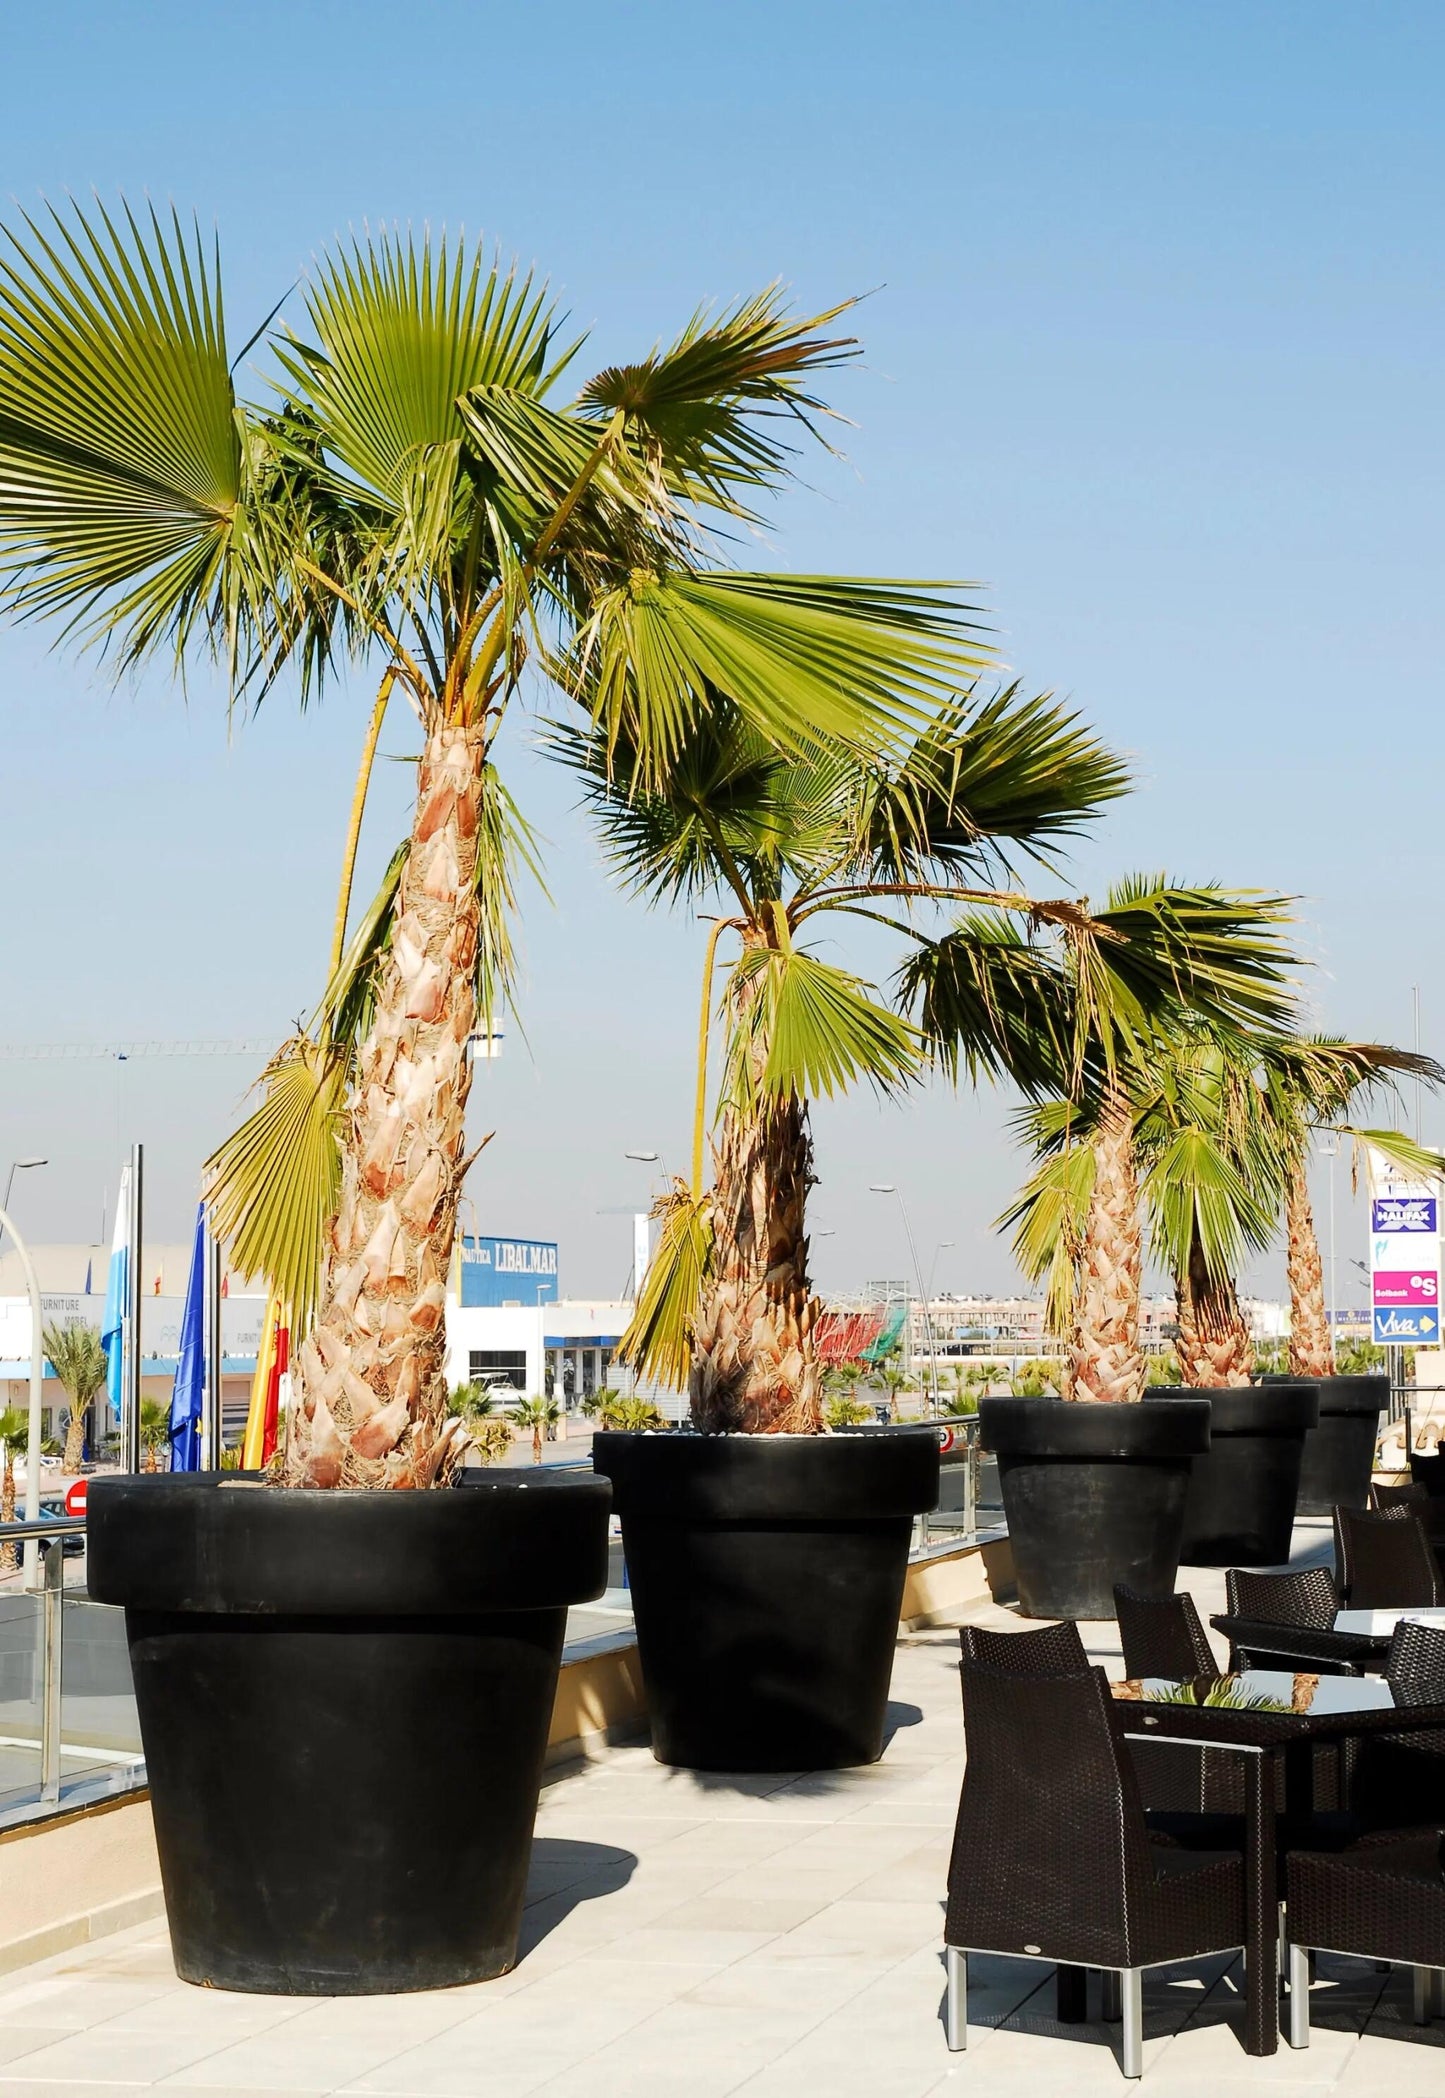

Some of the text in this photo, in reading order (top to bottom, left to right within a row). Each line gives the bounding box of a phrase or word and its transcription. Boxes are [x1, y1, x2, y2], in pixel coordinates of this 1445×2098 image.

[1377, 1211, 1430, 1221] HALIFAX
[495, 1243, 557, 1274] LIBALMAR
[40, 1299, 79, 1310] FURNITURE
[1376, 1311, 1417, 1334] Viva
